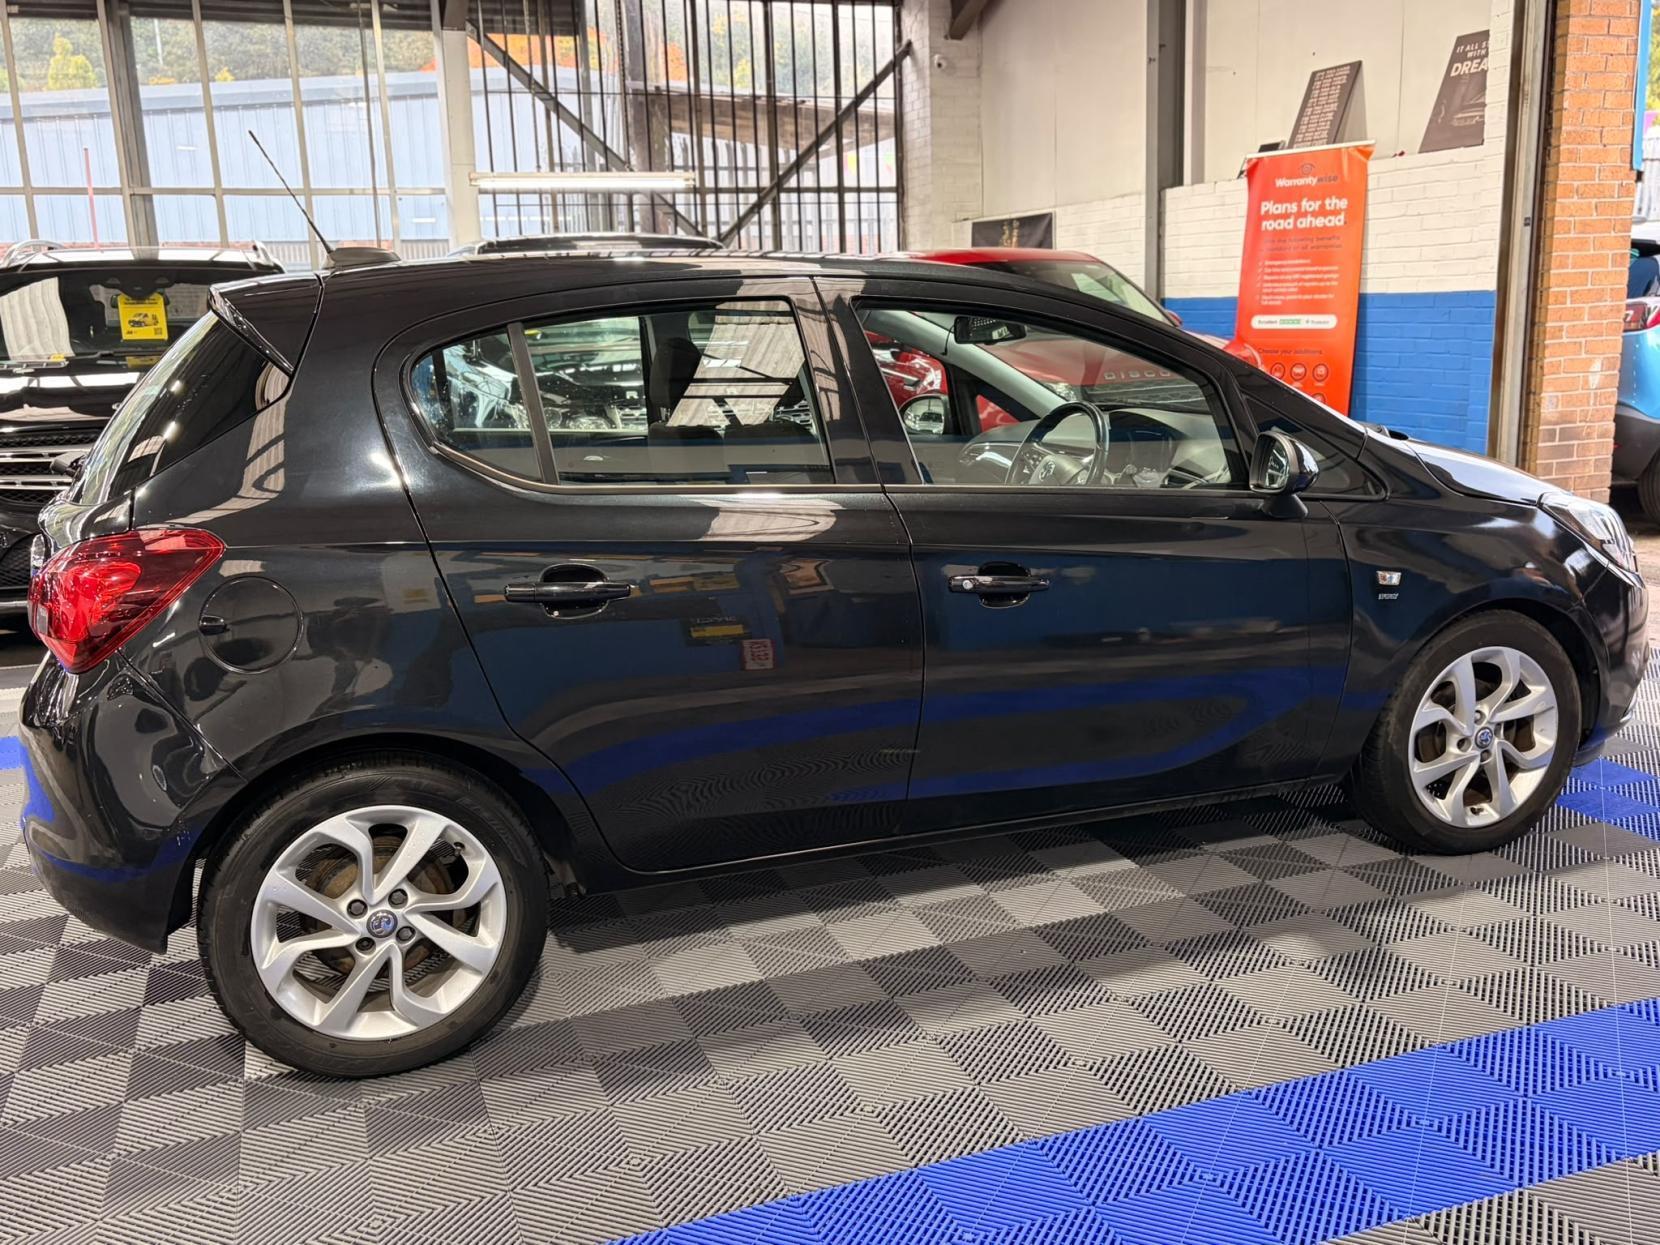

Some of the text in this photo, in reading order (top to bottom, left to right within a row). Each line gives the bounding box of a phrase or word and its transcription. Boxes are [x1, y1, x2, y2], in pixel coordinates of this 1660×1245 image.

[1456, 45, 1464, 54] IT
[1465, 42, 1479, 52] ALL
[1467, 48, 1487, 59] WITH
[1260, 195, 1348, 215] Plans for the
[1261, 215, 1295, 231] road
